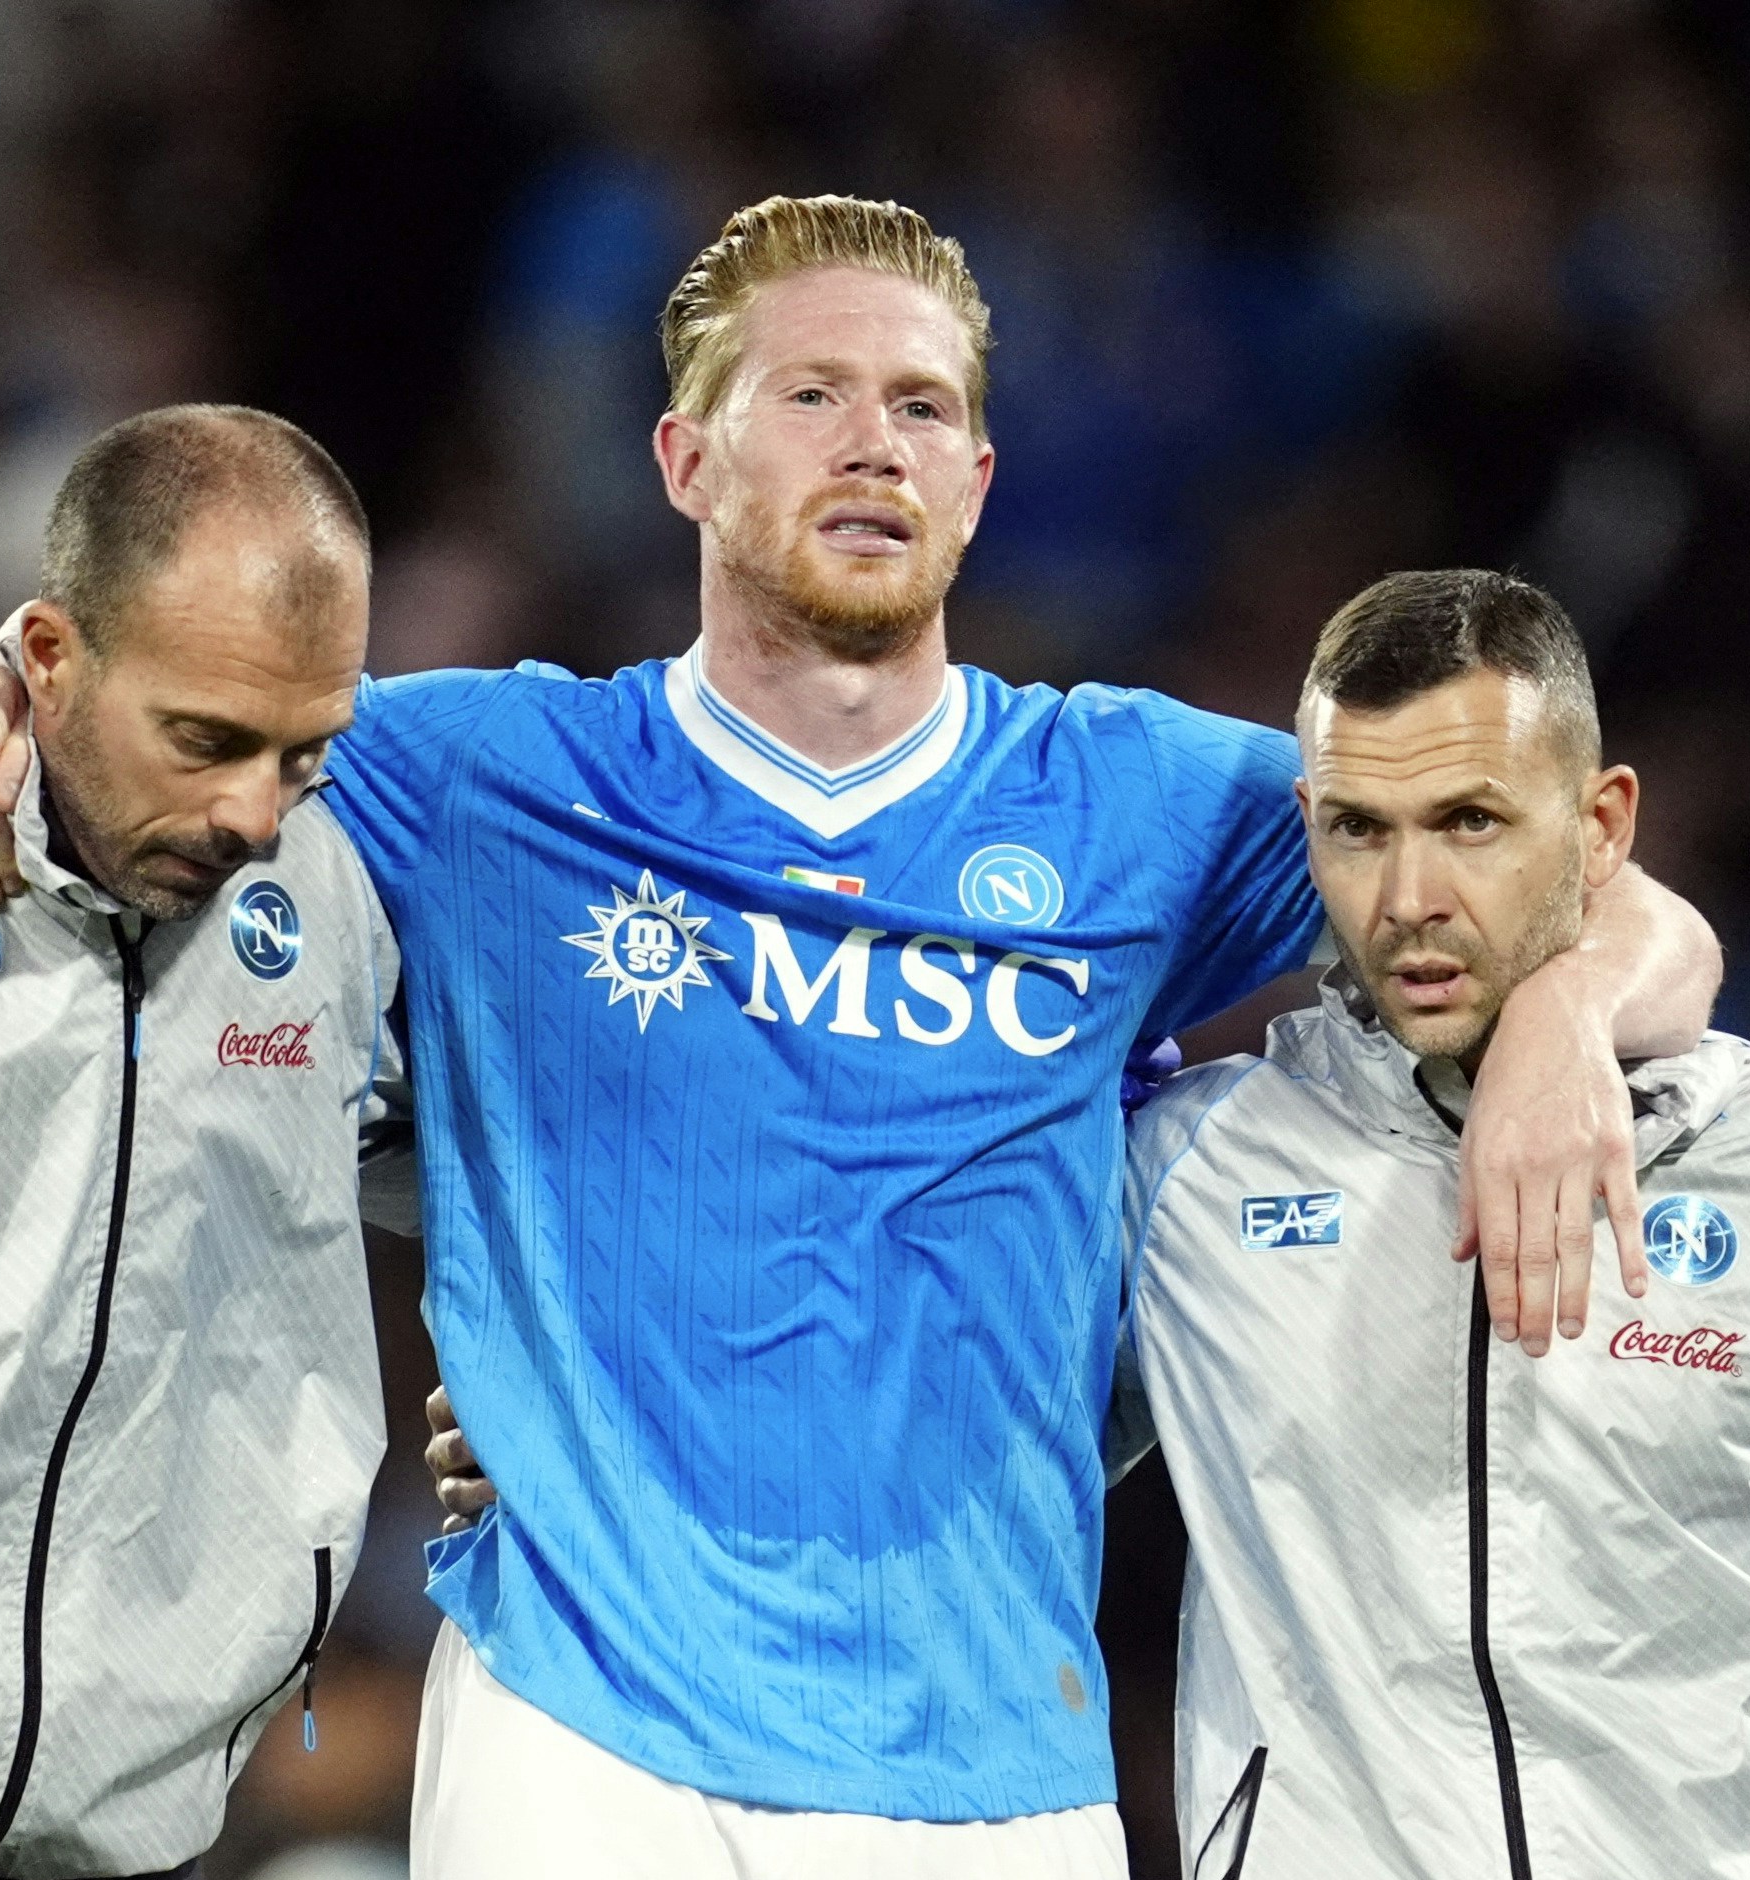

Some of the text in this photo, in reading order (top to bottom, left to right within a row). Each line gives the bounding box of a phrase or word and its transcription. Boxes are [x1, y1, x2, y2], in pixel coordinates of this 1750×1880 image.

[986, 871, 1035, 918] N
[250, 906, 284, 956] N
[740, 911, 1091, 1058] MSC
[217, 1021, 314, 1069] Coca-Cola
[1666, 1218, 1710, 1263] N
[1608, 1319, 1747, 1377] Coca-Cola
